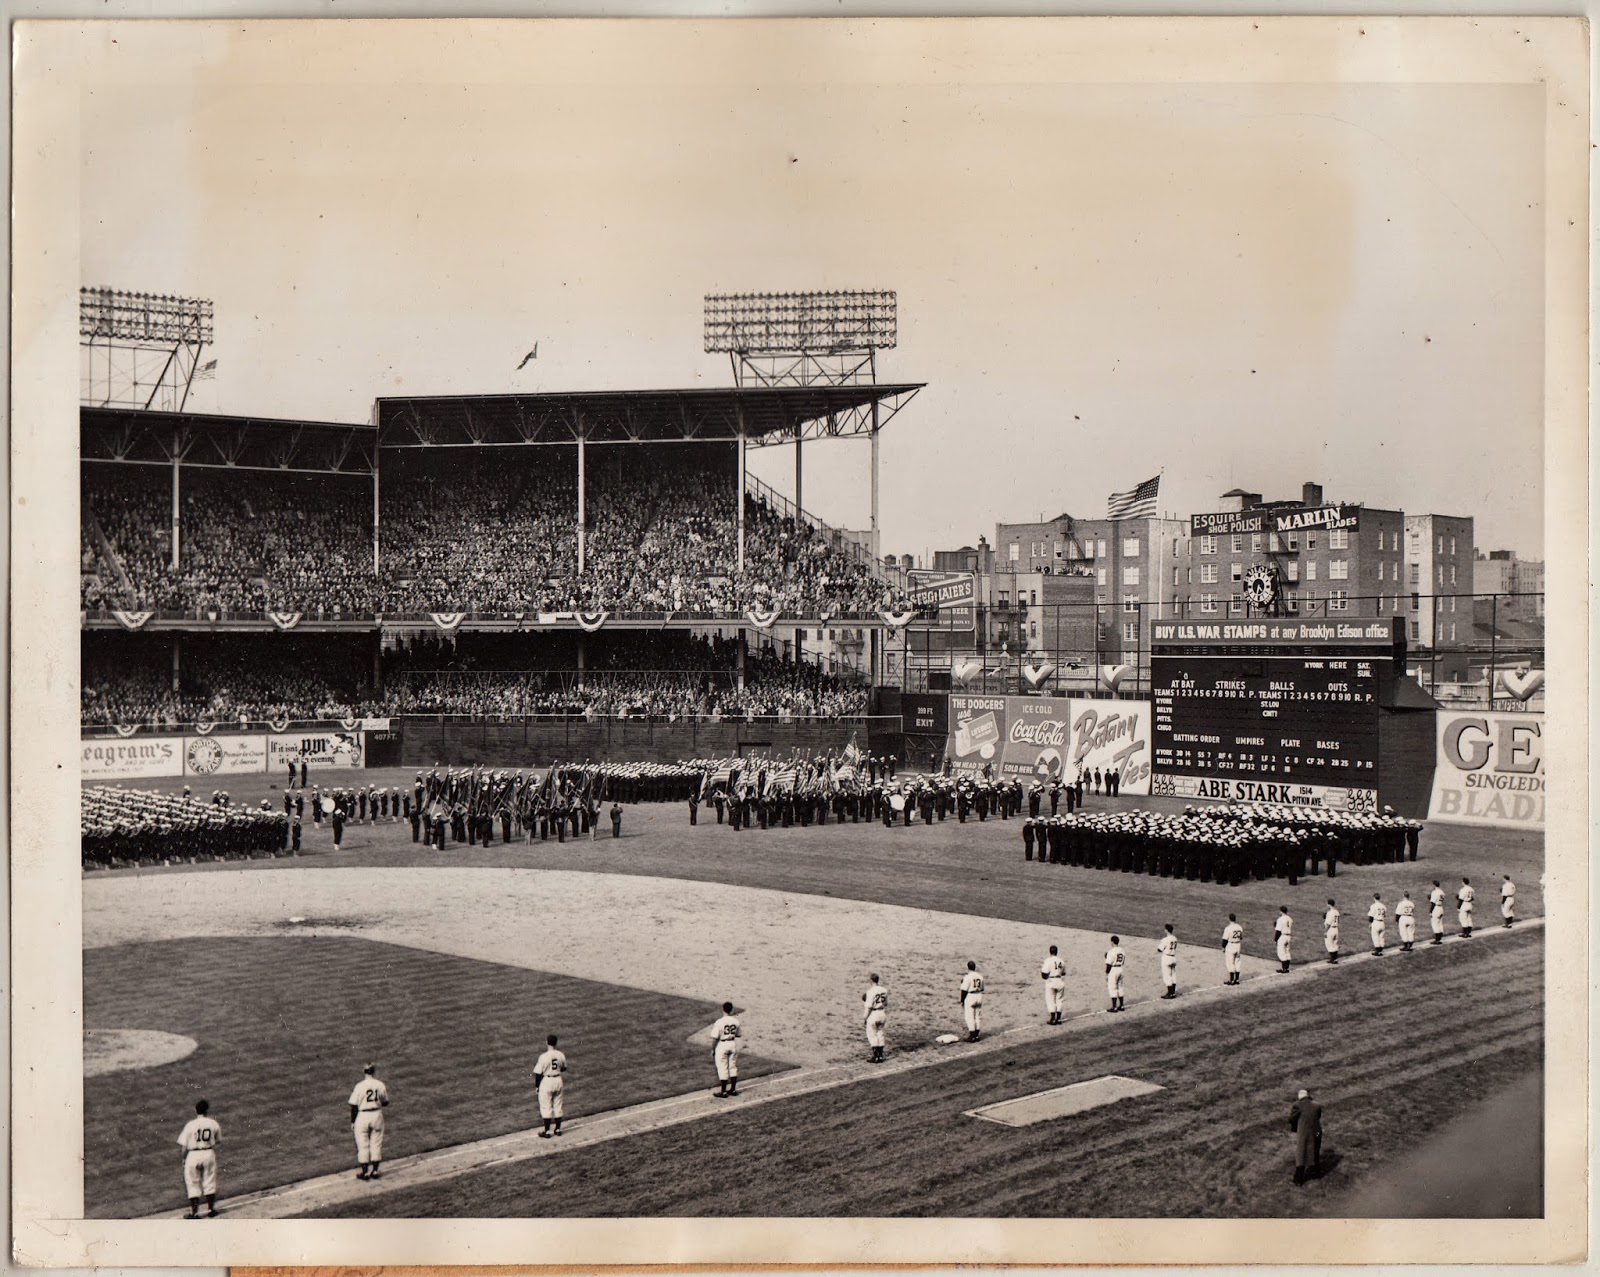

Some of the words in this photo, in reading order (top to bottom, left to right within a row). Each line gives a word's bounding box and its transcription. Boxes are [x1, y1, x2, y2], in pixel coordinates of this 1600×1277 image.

[1193, 514, 1241, 529] ESQUIRE
[1208, 525, 1228, 534] SHOE
[1230, 517, 1262, 533] POLISH
[1276, 508, 1341, 532] MARLIN
[1326, 516, 1357, 530] BLADES
[1155, 625, 1175, 639] BUY
[1178, 625, 1196, 639] U.S.
[1196, 625, 1221, 639] WAR
[1223, 625, 1267, 639] STAMPS
[1270, 626, 1280, 639] at
[1282, 628, 1298, 640] any
[1300, 624, 1335, 641] Brooklyn
[1337, 624, 1364, 638] Edison
[1366, 624, 1389, 638] office
[1171, 680, 1180, 689] AT
[1181, 680, 1196, 689] BAT
[1215, 681, 1247, 690] STRIKES
[1269, 682, 1295, 691] BALLS
[1328, 683, 1349, 691] OUTS
[1154, 689, 1175, 697] TEAMS
[1259, 691, 1281, 699] TEAMS
[1317, 692, 1322, 700] 6
[1323, 692, 1329, 700] 7
[1331, 692, 1336, 700] 8
[1338, 692, 1343, 700] 9
[1344, 692, 1351, 700] 10
[952, 699, 967, 709] THE
[968, 699, 1005, 710] DODGERS
[1022, 705, 1034, 713] ICE
[1035, 705, 1053, 714] COLD
[915, 718, 934, 727] EXIT
[374, 733, 386, 741] 407
[1073, 708, 1138, 760] Botany
[1173, 734, 1199, 742] BATTING
[1200, 735, 1221, 743] ORDER
[271, 741, 278, 753] If
[278, 743, 284, 753] it
[1236, 737, 1265, 746] UMPIRES
[1280, 739, 1301, 748] PLATE
[1316, 740, 1340, 749] BASES
[1443, 716, 1544, 775] GE
[82, 743, 173, 767] eagram's
[962, 761, 977, 770] HEAD
[1004, 764, 1020, 773] SOLD
[1020, 765, 1034, 774] HERE
[1113, 740, 1150, 788] Ties
[1465, 773, 1544, 793] SINGLED
[1197, 779, 1231, 799] ABE
[1236, 782, 1292, 804] STARK
[1299, 786, 1313, 796] 1514
[1437, 788, 1544, 822] BLAD
[1054, 961, 1063, 970] 14
[874, 993, 887, 1004] 25
[723, 1024, 737, 1036] 32
[551, 1058, 558, 1071] 5
[366, 1089, 379, 1103] 21
[195, 1128, 212, 1143] 10
